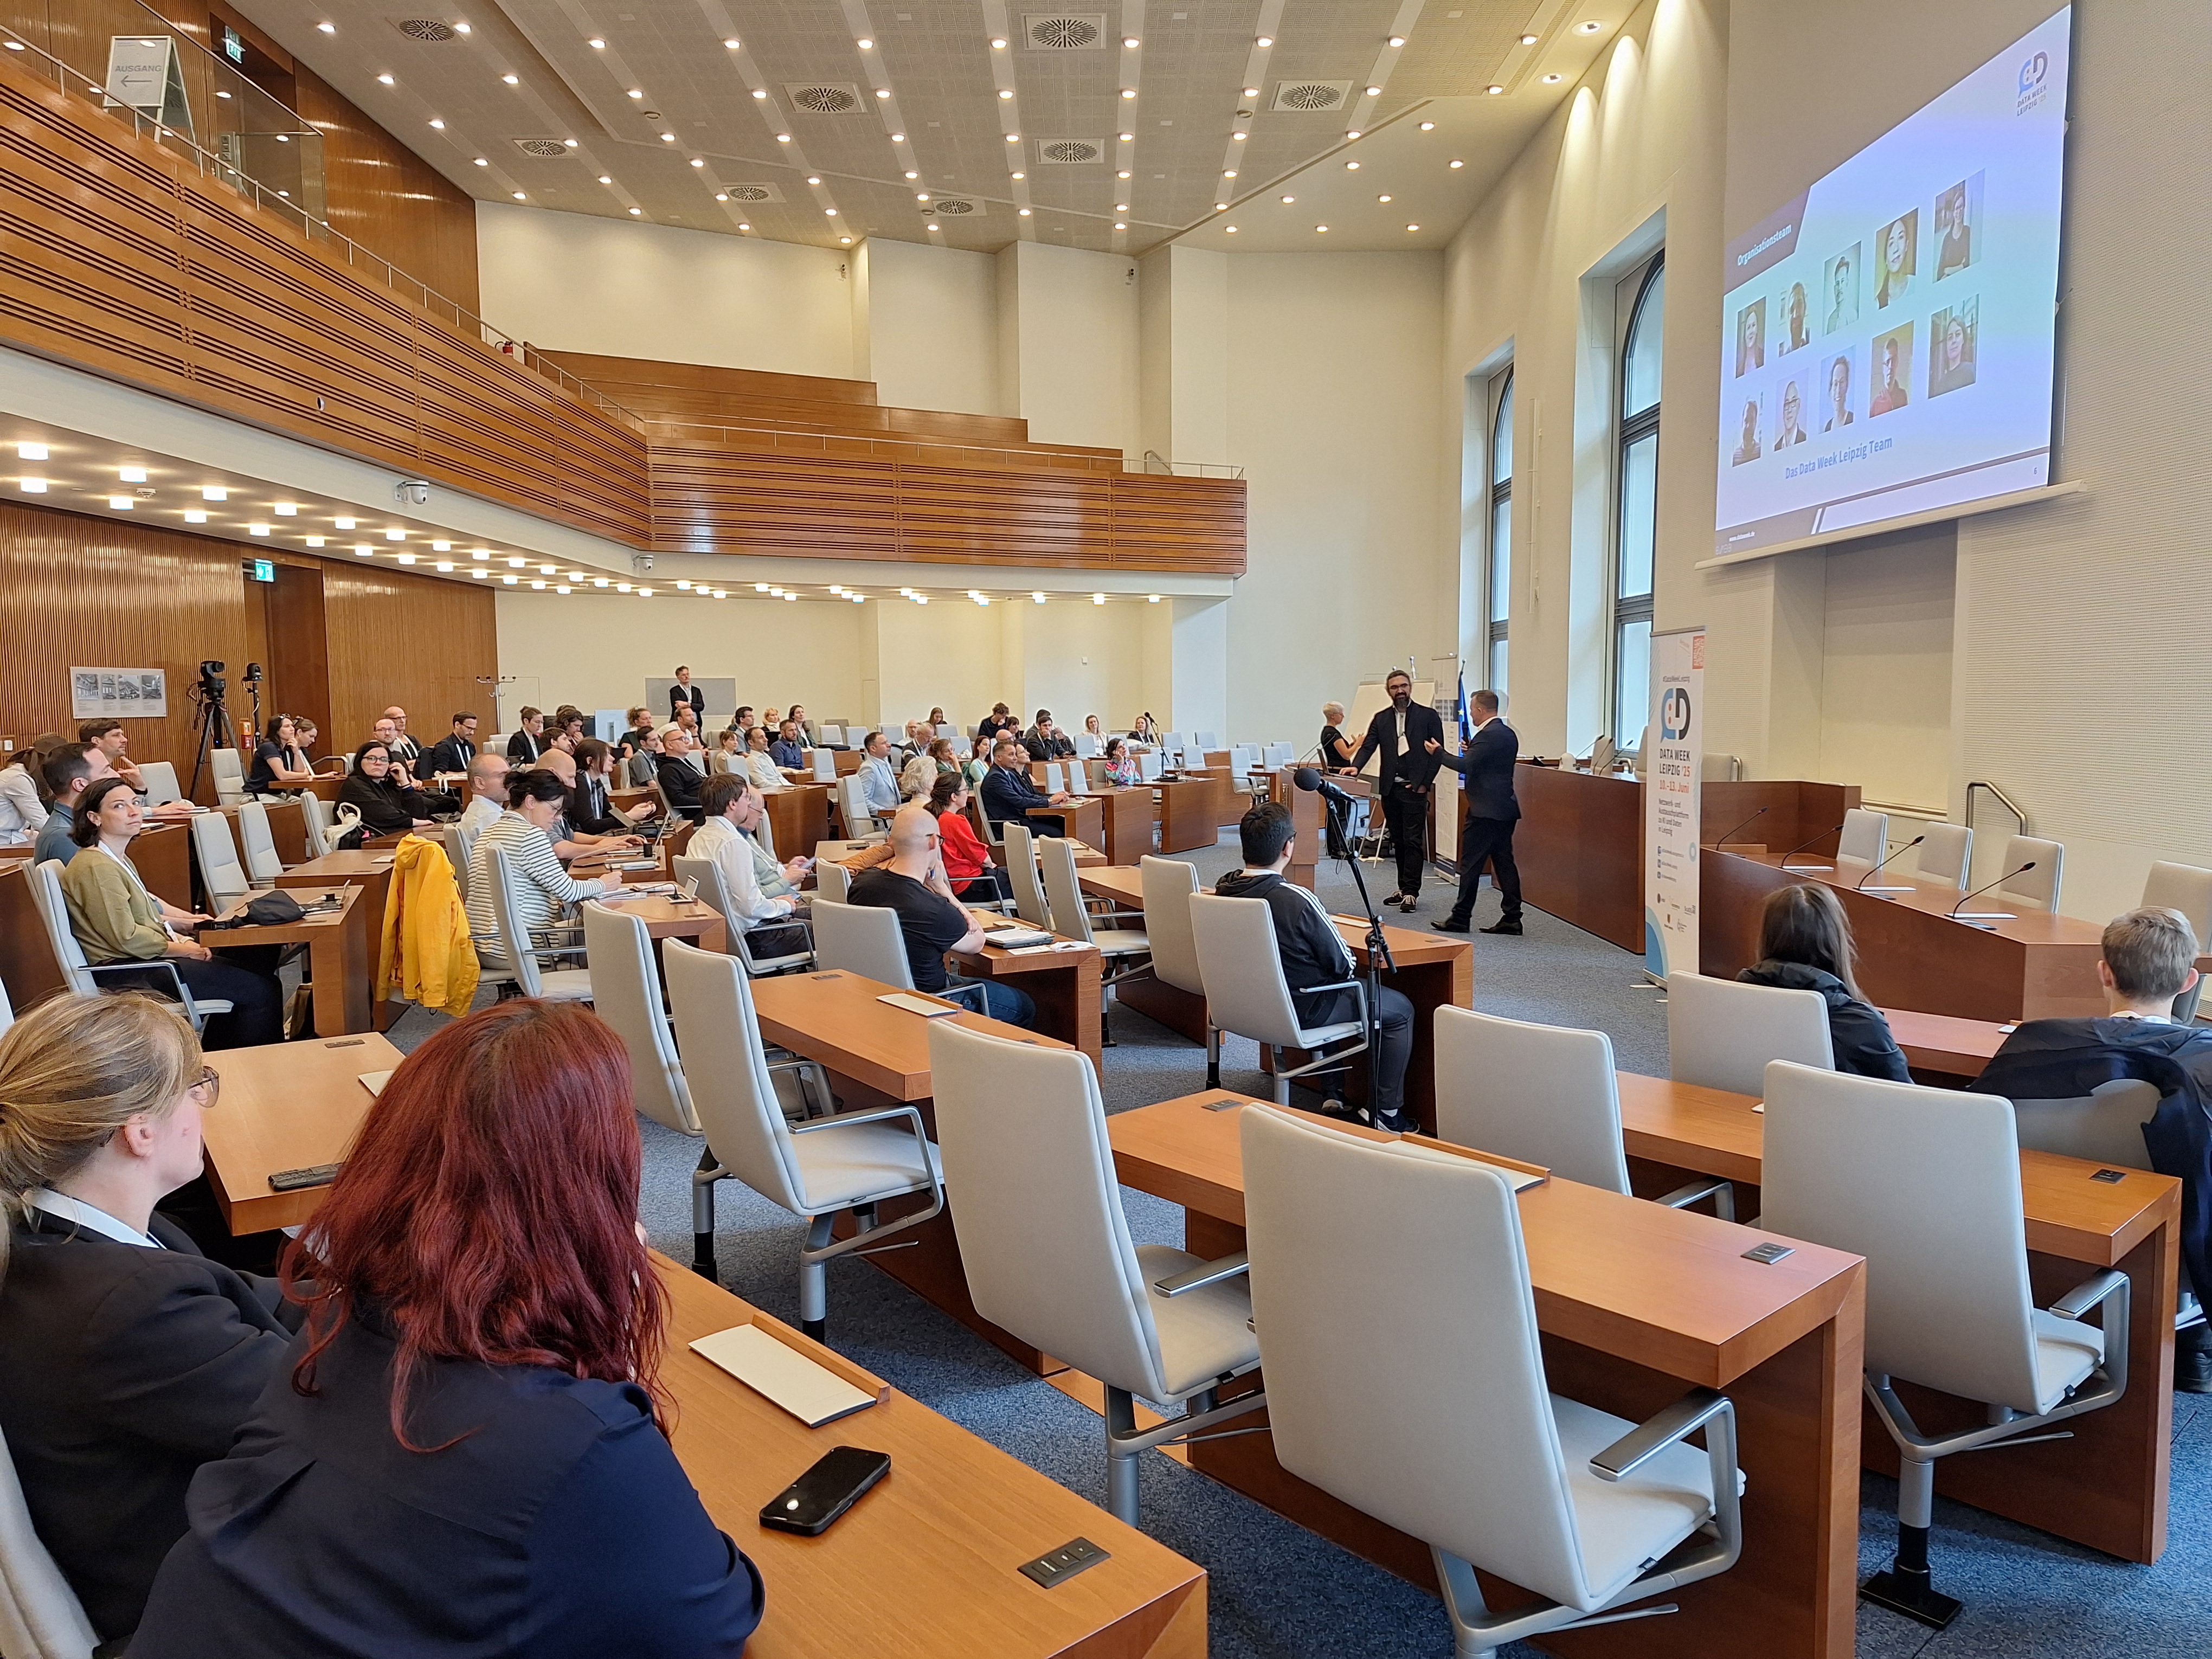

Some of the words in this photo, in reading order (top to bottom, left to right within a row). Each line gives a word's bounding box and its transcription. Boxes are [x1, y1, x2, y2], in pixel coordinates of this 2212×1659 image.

[2017, 95, 2030, 107] DATA
[2031, 83, 2047, 98] WEEK
[2017, 99, 2037, 117] LEIPZIG
[1738, 224, 1792, 266] Organisationsteam
[1785, 467, 1798, 479] Das
[1799, 460, 1816, 475] Data
[1817, 452, 1838, 470] Week
[1839, 442, 1868, 463] Leipzig
[1869, 437, 1893, 454] Team
[2034, 467, 2038, 475] 6
[1660, 748, 1674, 760] DATA
[1674, 749, 1690, 762] WEEK
[1660, 763, 1680, 776] LEIPZIG
[1682, 766, 1690, 777] '25
[1678, 782, 1689, 794] Juni
